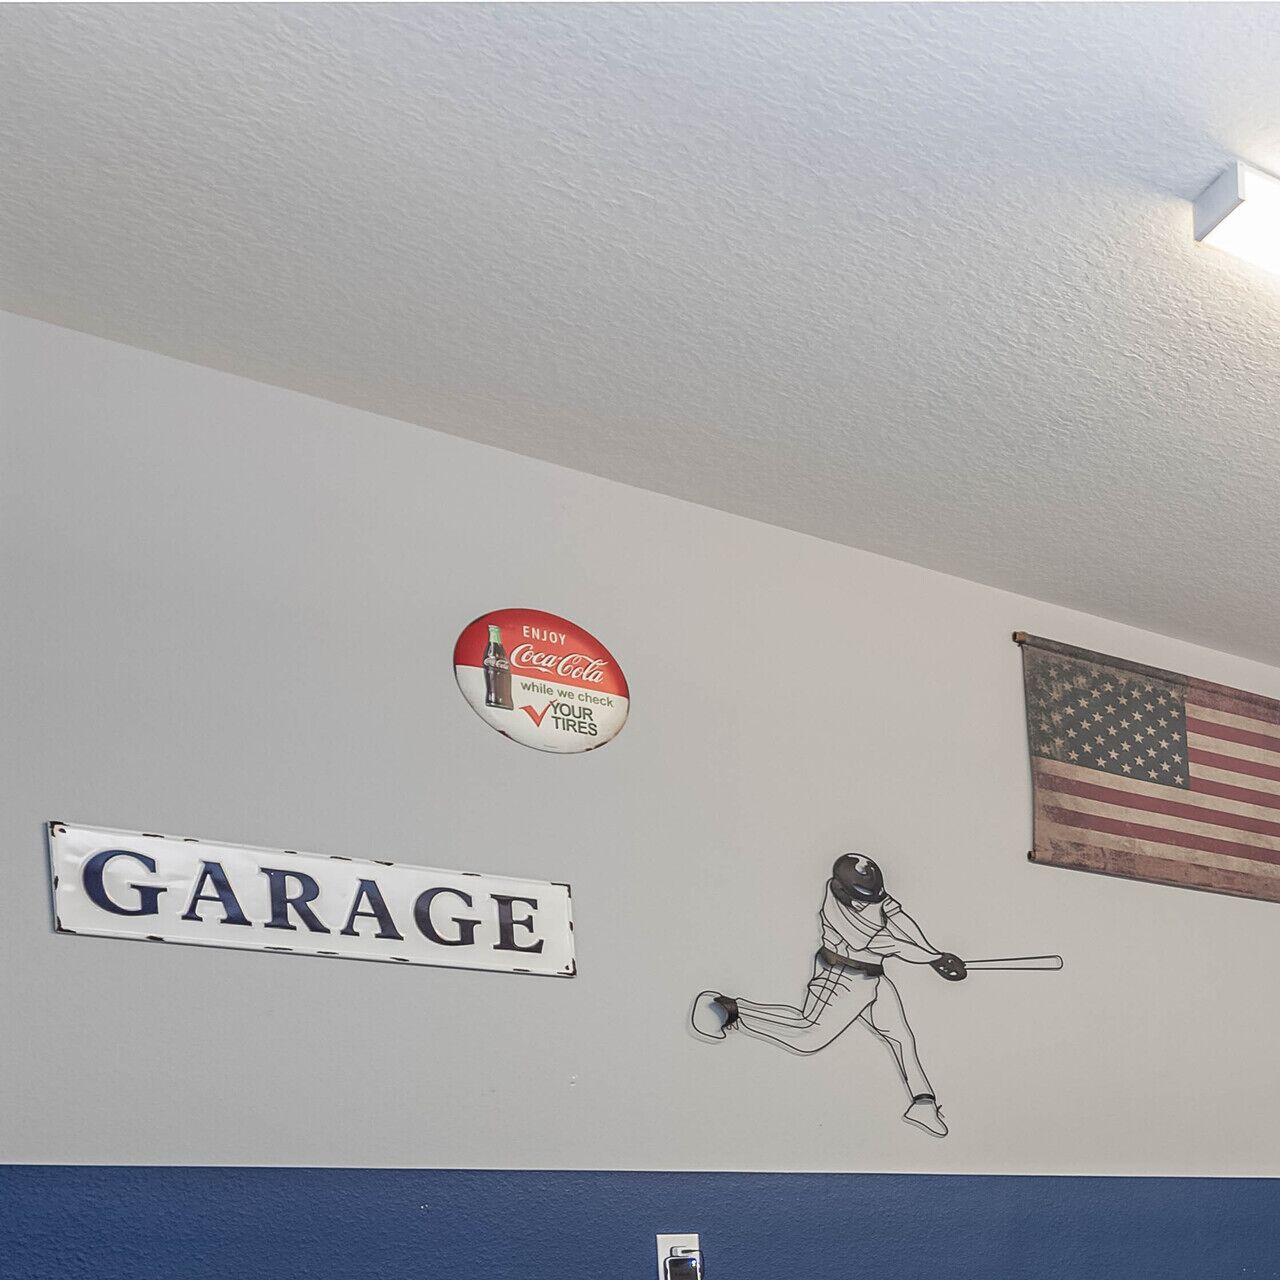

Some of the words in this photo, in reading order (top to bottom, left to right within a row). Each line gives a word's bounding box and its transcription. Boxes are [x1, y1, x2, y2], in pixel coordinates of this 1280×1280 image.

[522, 625, 567, 646] ENJOY
[520, 681, 554, 696] while
[556, 689, 575, 700] we
[577, 691, 615, 708] check
[549, 701, 593, 722] YOUR
[551, 715, 598, 736] TIRES
[81, 848, 546, 955] GARAGE
